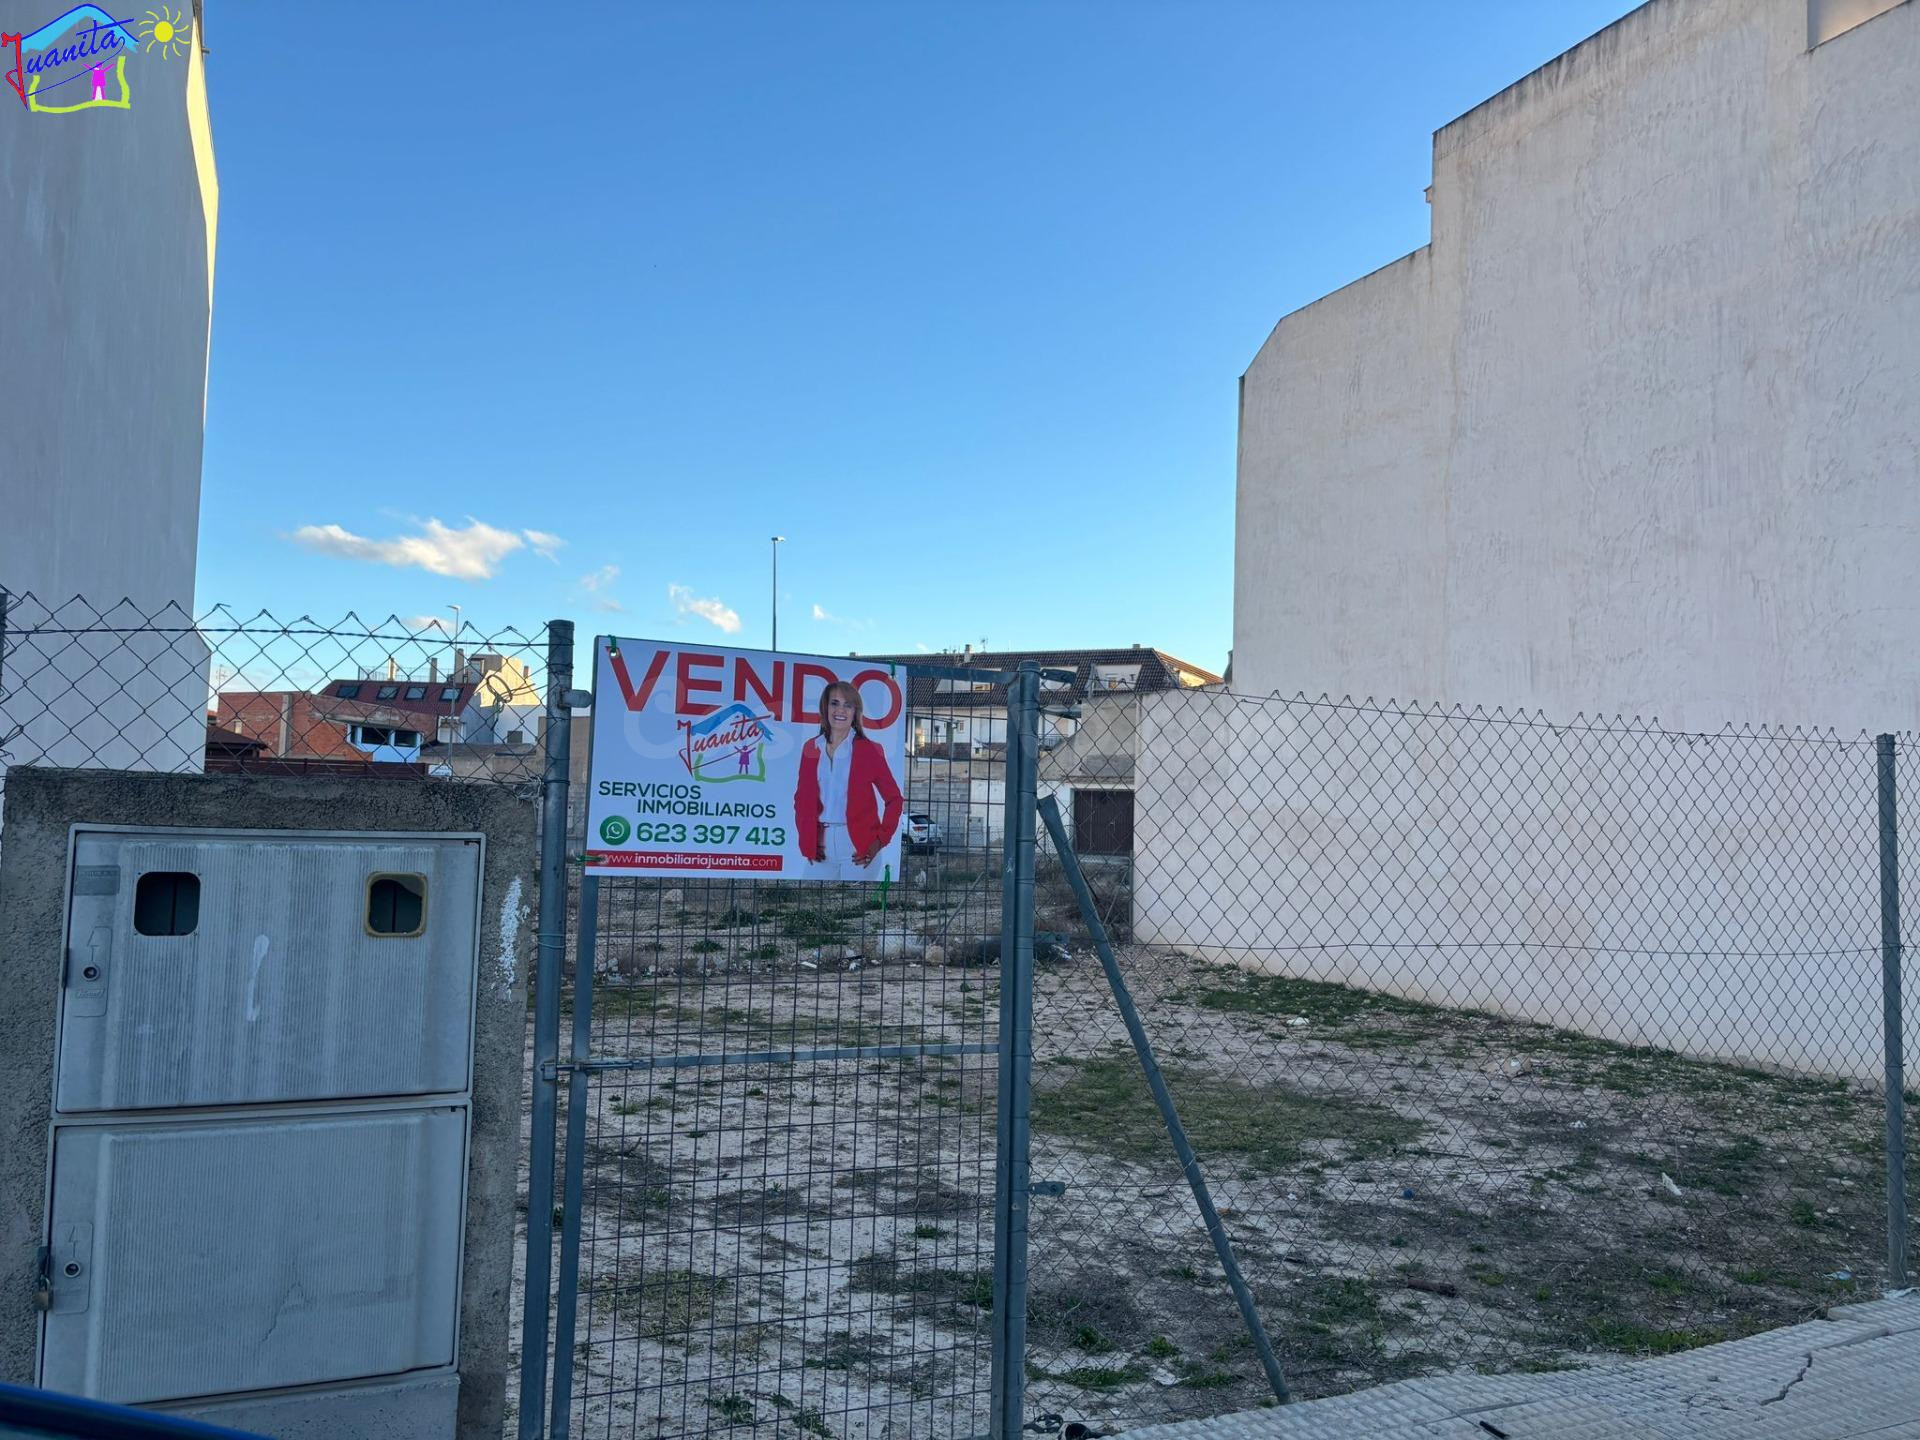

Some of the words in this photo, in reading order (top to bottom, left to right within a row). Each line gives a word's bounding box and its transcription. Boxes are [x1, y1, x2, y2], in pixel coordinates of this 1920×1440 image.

[605, 646, 903, 730] VENDO
[677, 714, 771, 776] Juanita
[598, 781, 701, 800] SERVICIOS
[637, 800, 776, 818] INMOBILIARIOS
[637, 823, 687, 843] 623
[693, 825, 740, 845] 397
[745, 826, 786, 846] 413
[602, 852, 778, 869] ww.inmobiliariajuanita.com
